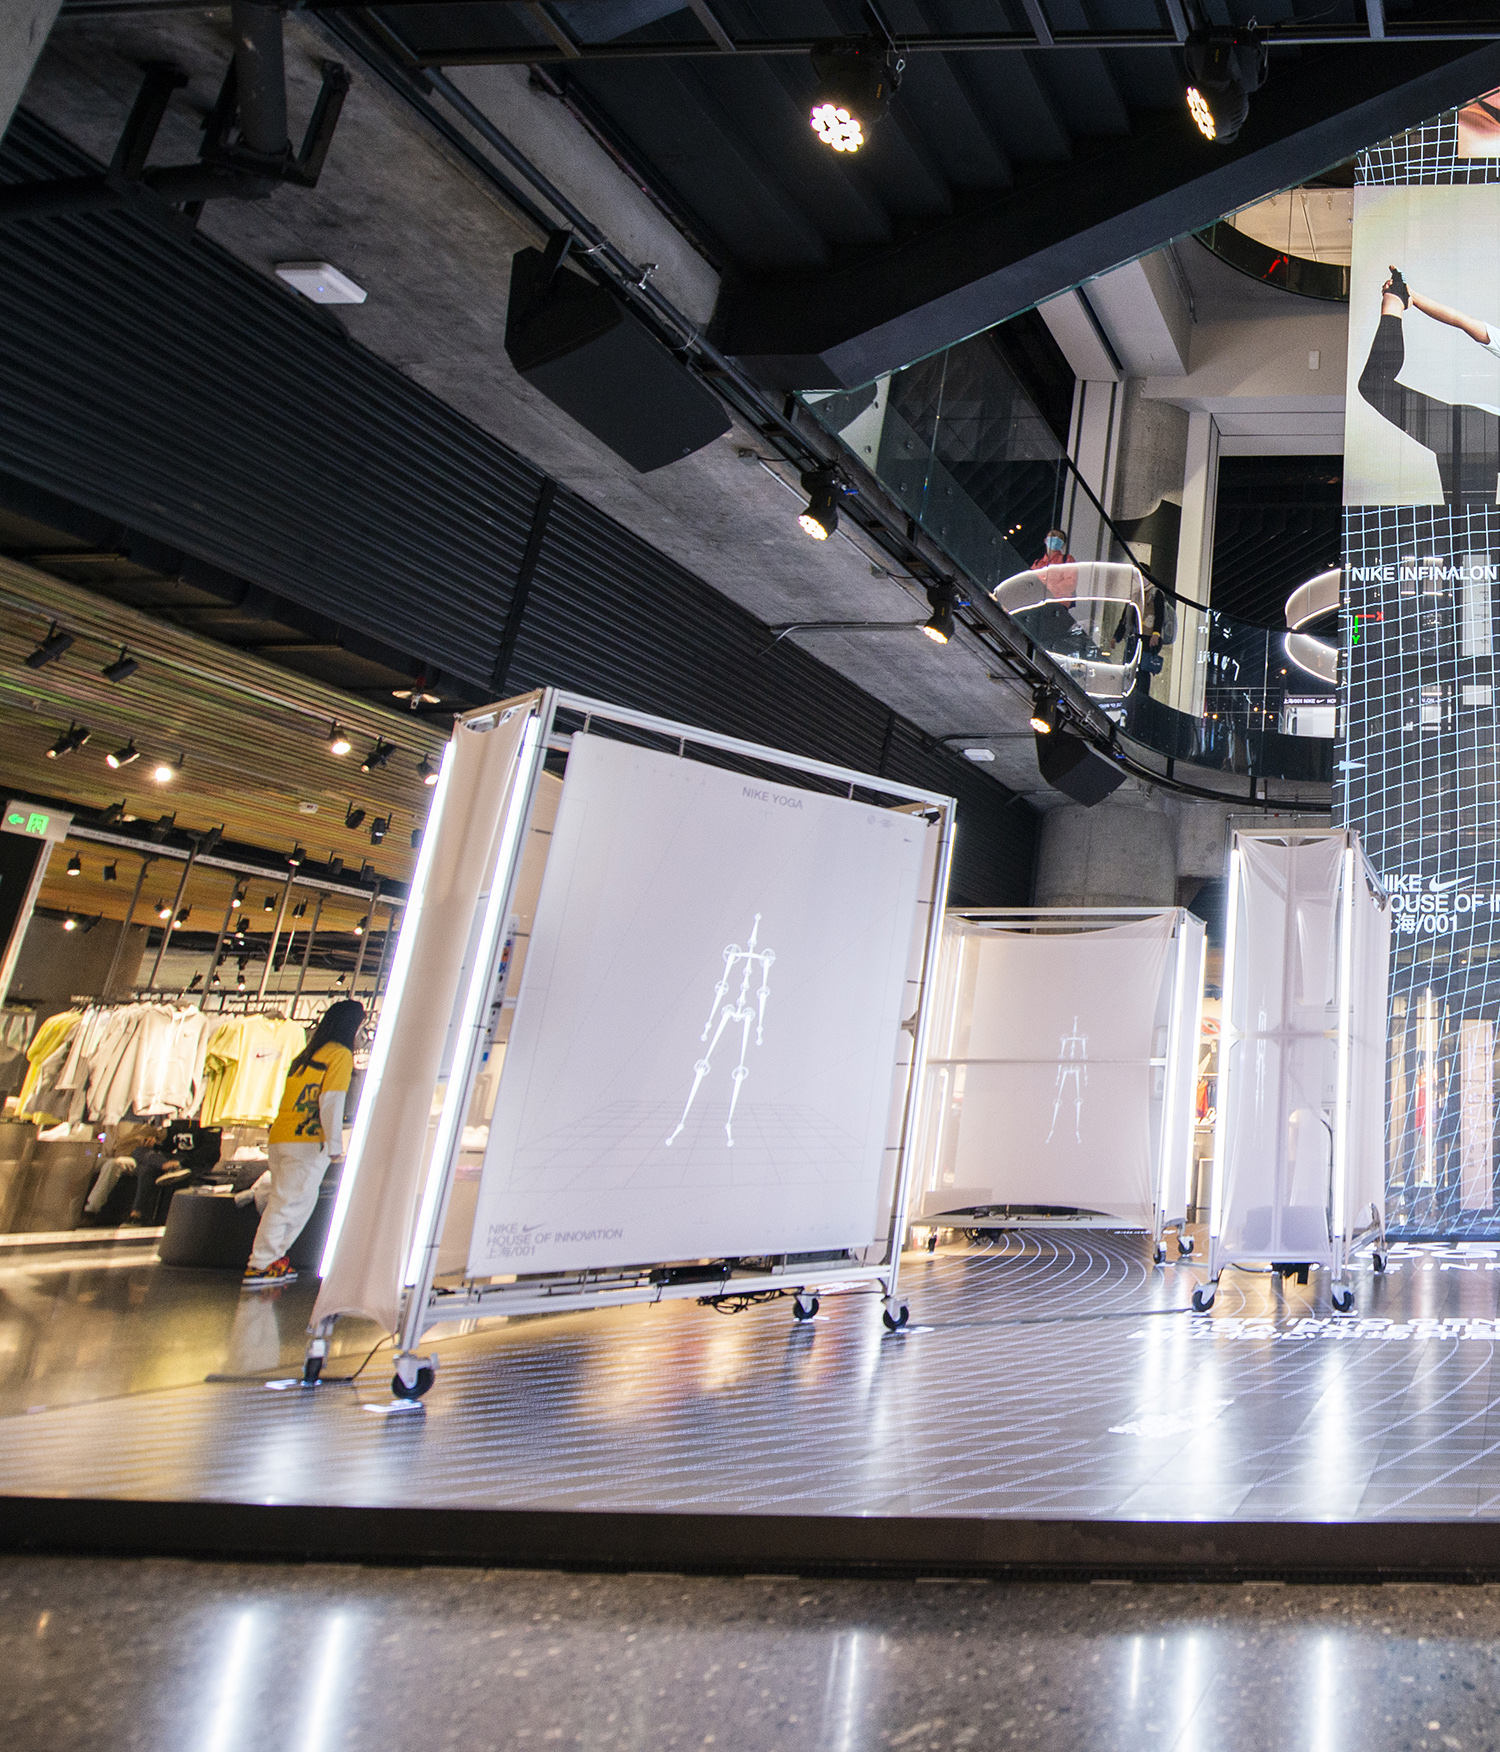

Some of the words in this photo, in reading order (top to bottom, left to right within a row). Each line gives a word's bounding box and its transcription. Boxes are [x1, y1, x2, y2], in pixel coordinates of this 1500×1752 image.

[1351, 567, 1395, 582] NIKE
[1400, 565, 1498, 581] INFINALON
[742, 787, 769, 802] NIKE
[772, 794, 803, 809] YOGA
[1390, 894, 1449, 913] OUSE
[1454, 894, 1484, 913] OF
[1390, 913, 1458, 935] 海/001
[487, 1234, 532, 1247] HOUSE
[534, 1232, 551, 1244] OF
[554, 1228, 623, 1243] INNOVATION
[488, 1222, 518, 1235] NIKE
